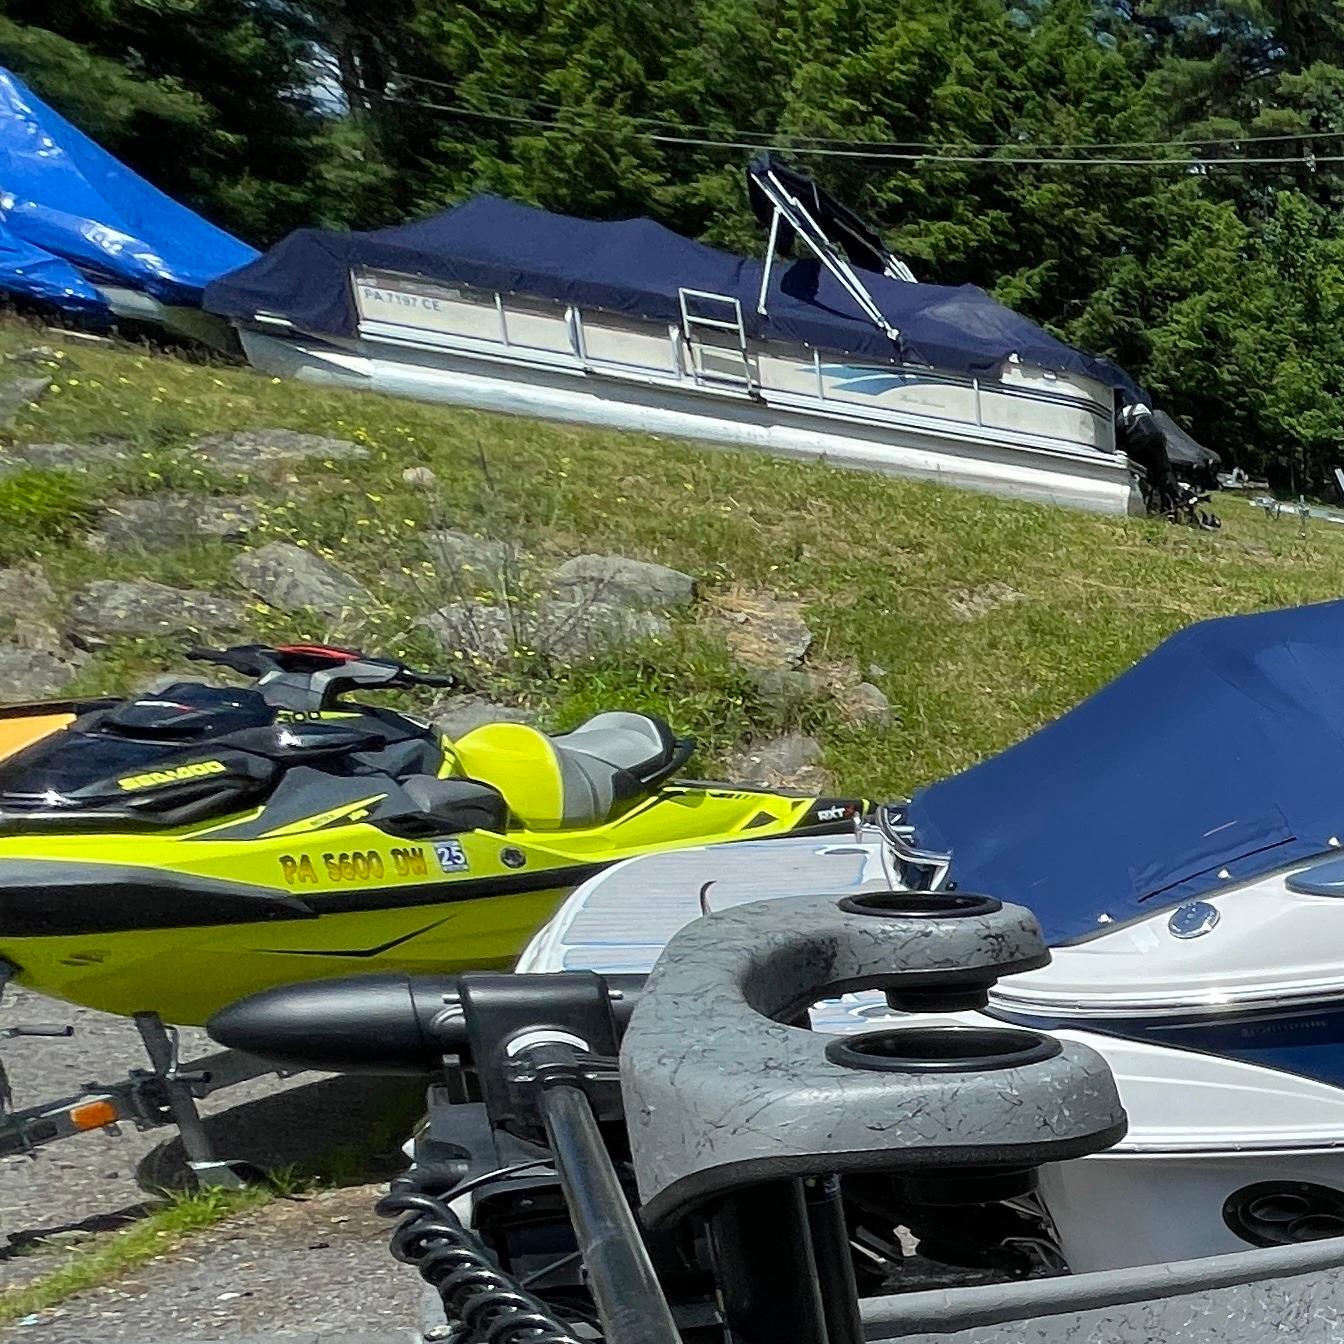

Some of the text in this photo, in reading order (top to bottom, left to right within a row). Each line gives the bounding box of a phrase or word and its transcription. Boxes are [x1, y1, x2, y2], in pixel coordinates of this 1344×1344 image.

[278, 853, 319, 885] PA
[322, 849, 385, 882] 5600
[437, 846, 466, 866] 25
